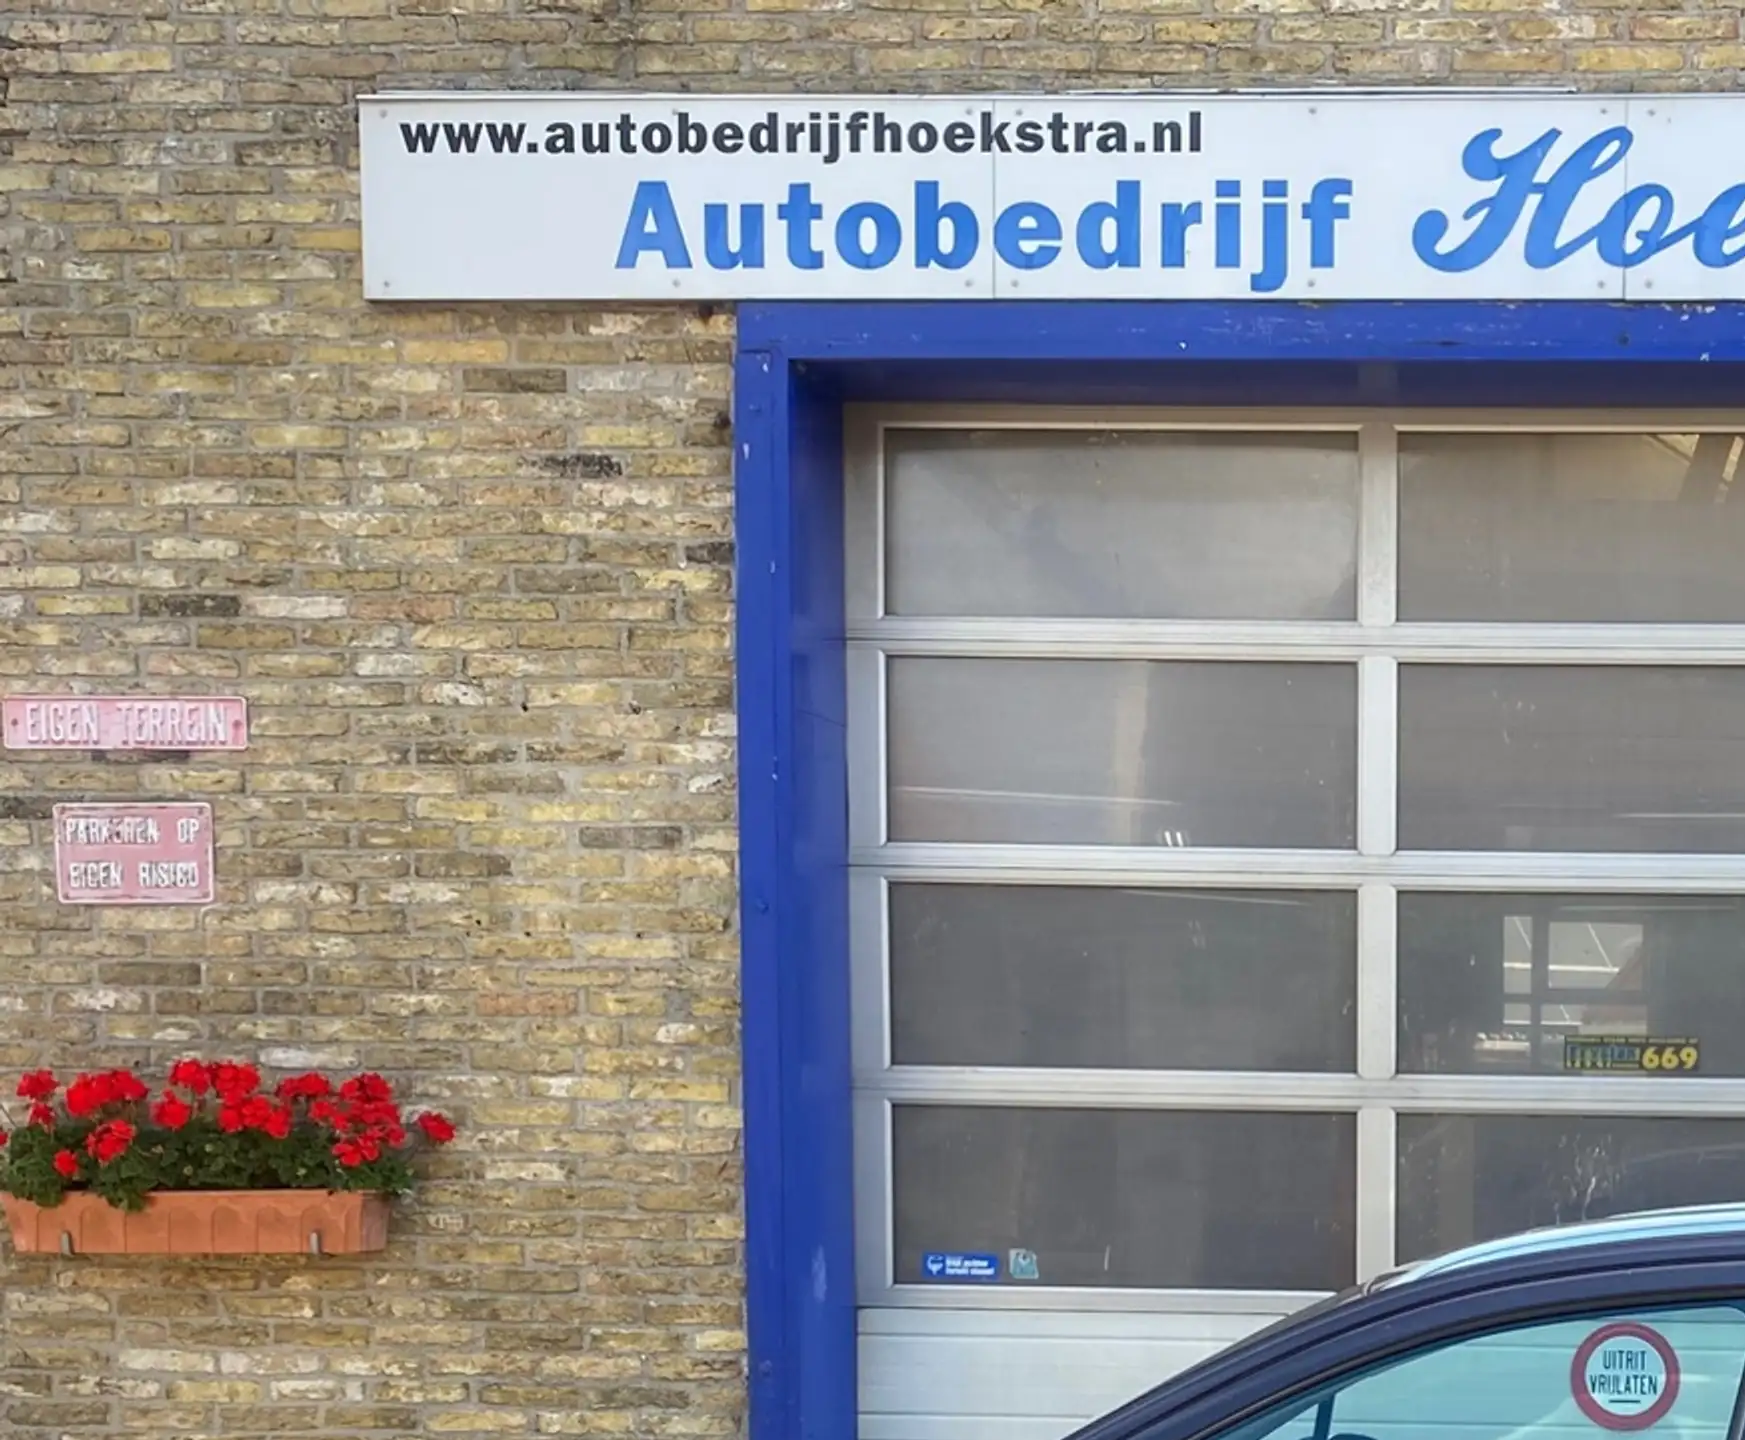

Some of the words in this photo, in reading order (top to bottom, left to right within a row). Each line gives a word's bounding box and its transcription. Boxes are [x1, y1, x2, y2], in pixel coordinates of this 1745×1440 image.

[400, 111, 1203, 163] www.autobedrijfhoekstra.nl
[614, 178, 1353, 293] Autobedrijf
[26, 703, 99, 744] EIGEN
[116, 703, 229, 745] TERREIN
[177, 817, 200, 844] OP
[69, 861, 123, 889] EIGEN
[1642, 1046, 1698, 1070] 669
[1602, 1350, 1647, 1371] UITRIT
[1590, 1374, 1658, 1396] VRIJLATEN
